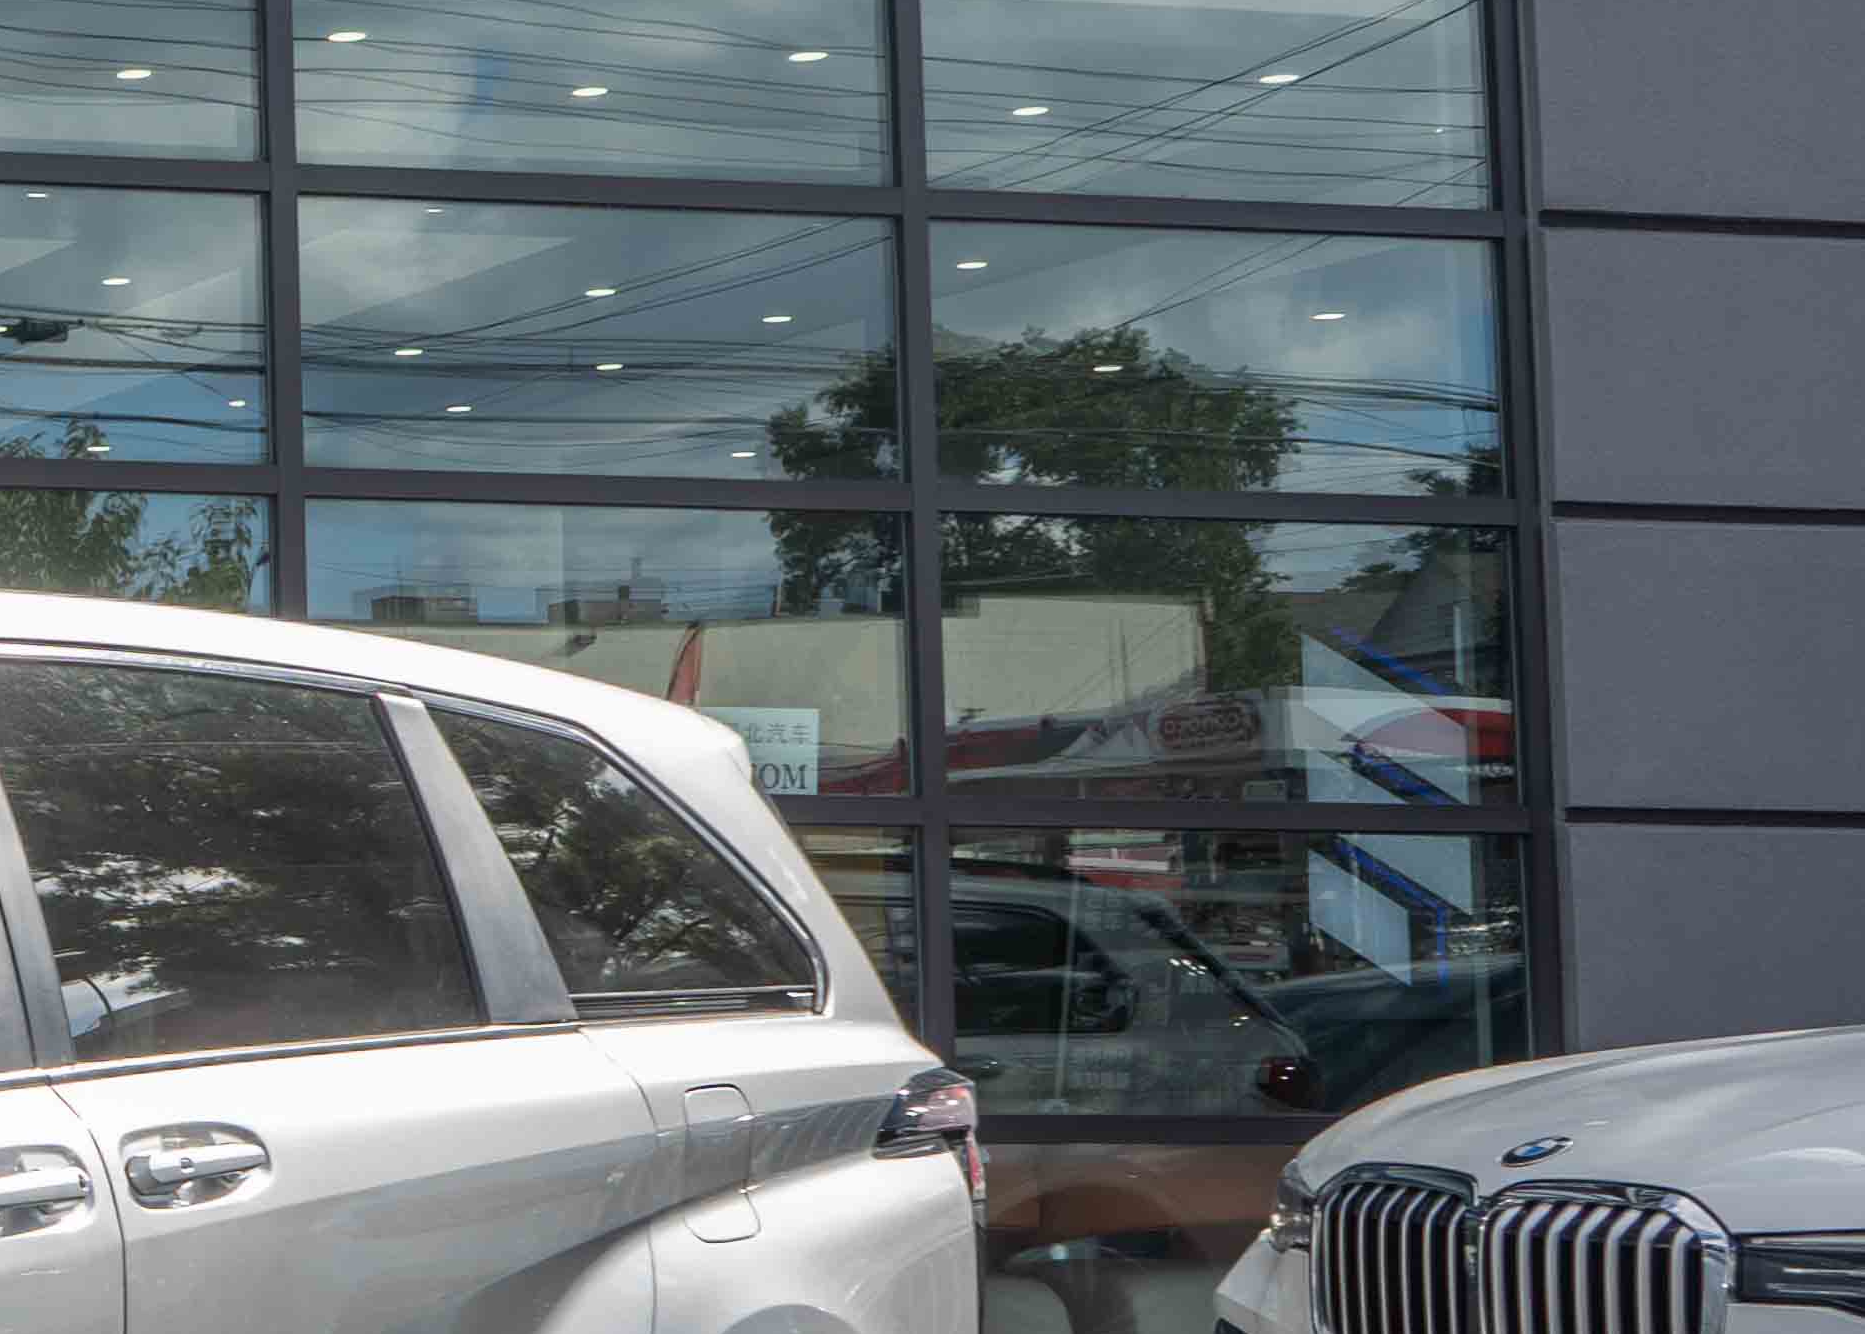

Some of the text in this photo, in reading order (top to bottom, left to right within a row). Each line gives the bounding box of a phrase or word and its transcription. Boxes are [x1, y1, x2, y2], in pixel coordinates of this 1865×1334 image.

[733, 722, 811, 746] 北汽车
[751, 763, 809, 790] OM
